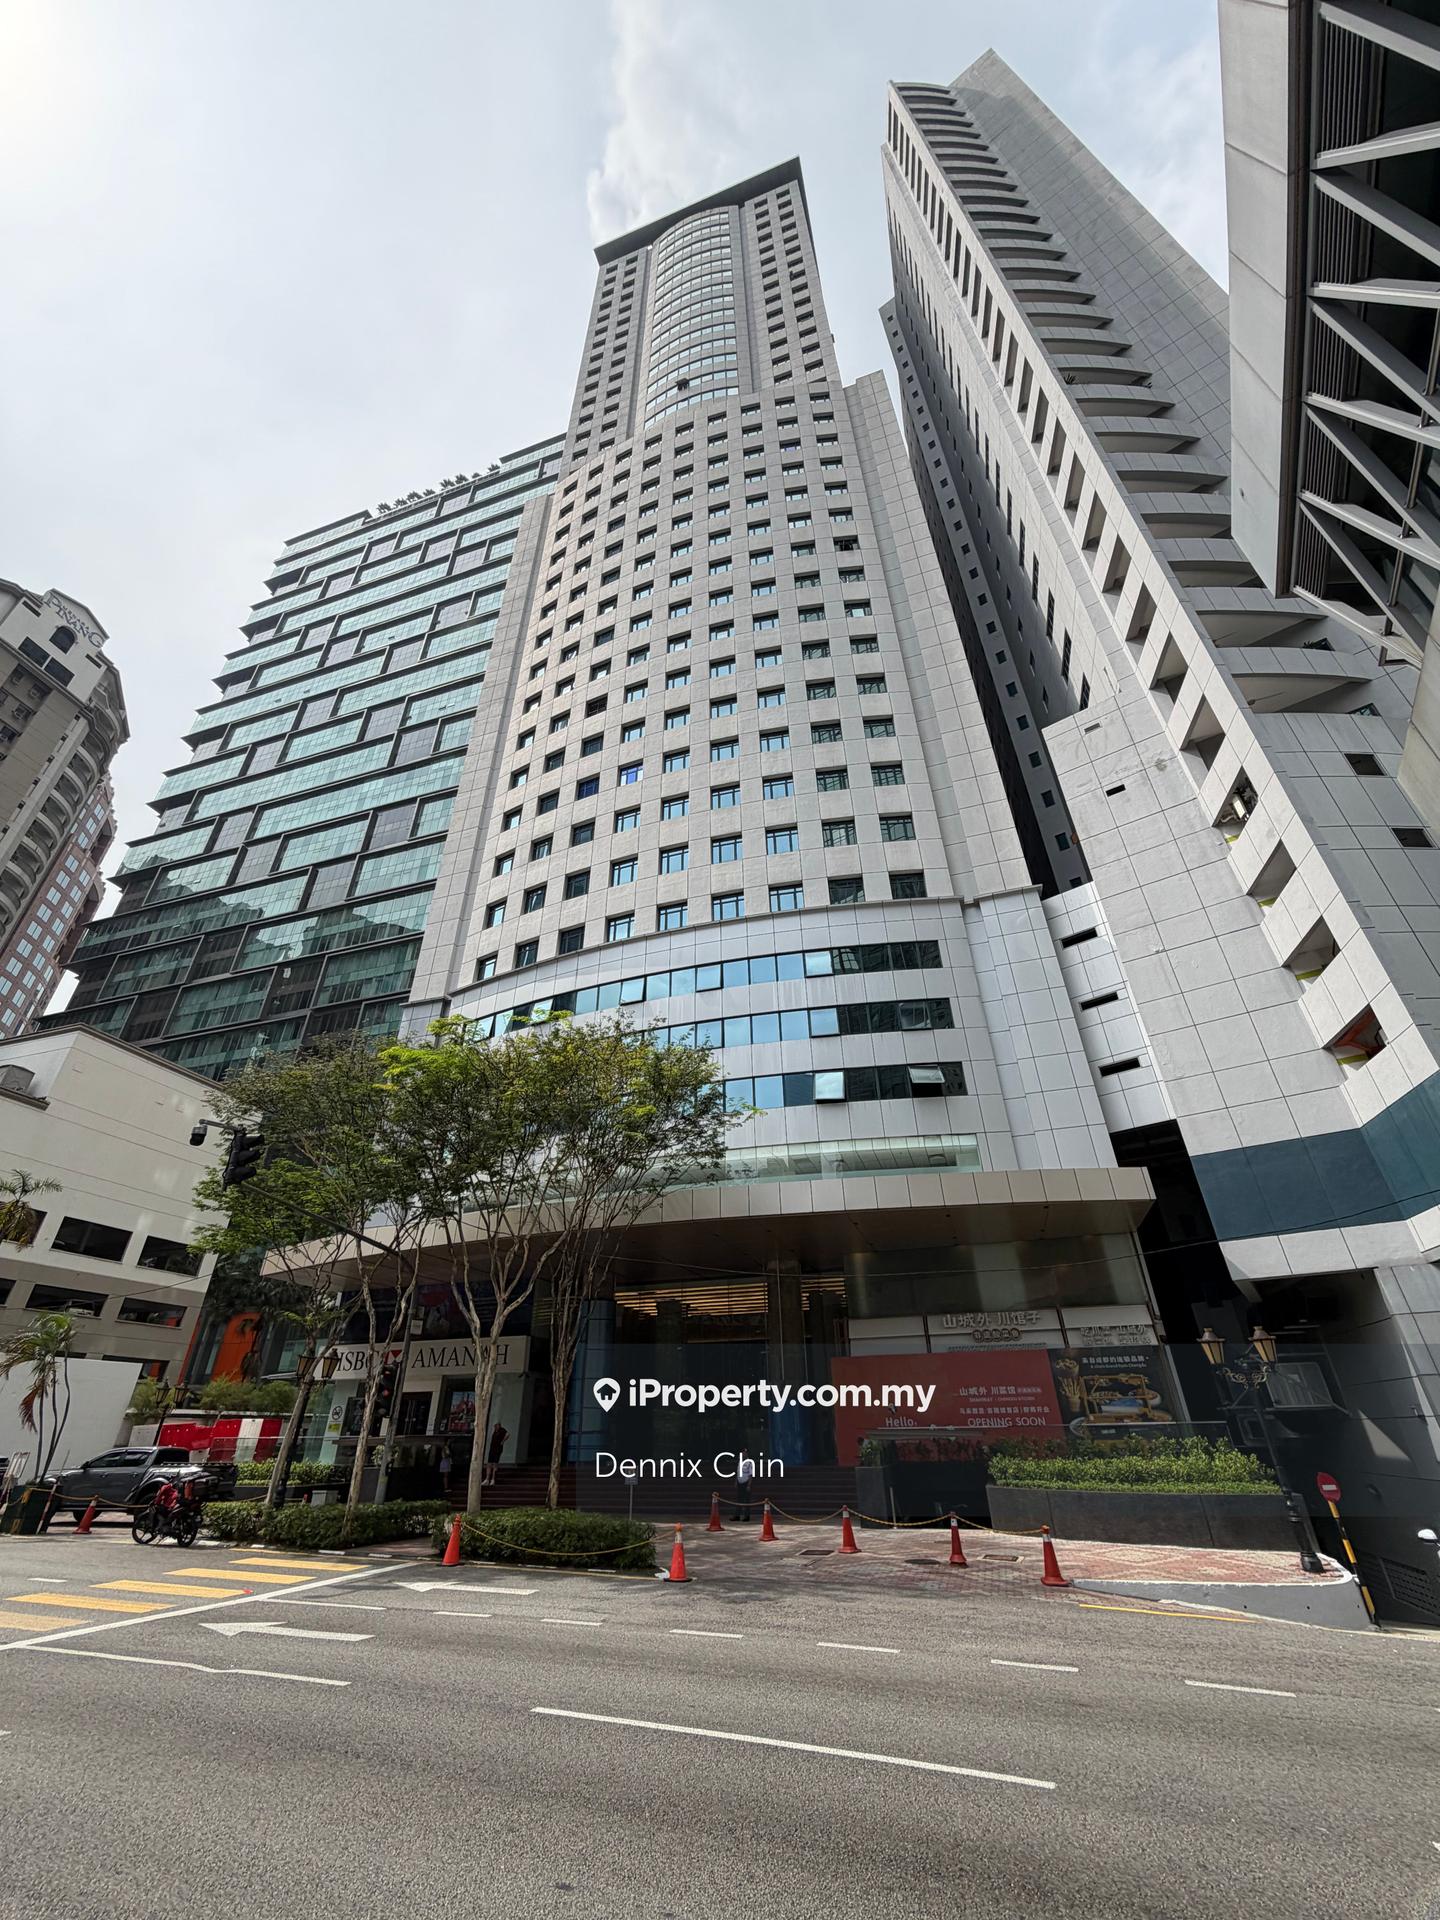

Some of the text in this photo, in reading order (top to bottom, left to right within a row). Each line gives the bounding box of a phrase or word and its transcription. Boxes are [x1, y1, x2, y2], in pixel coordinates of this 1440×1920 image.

[44, 591, 106, 648] PINANG
[942, 1310, 1041, 1328] 山城外 川馆子
[411, 1344, 510, 1369] AMANAH
[967, 1416, 1047, 1427] OPENING SOON
